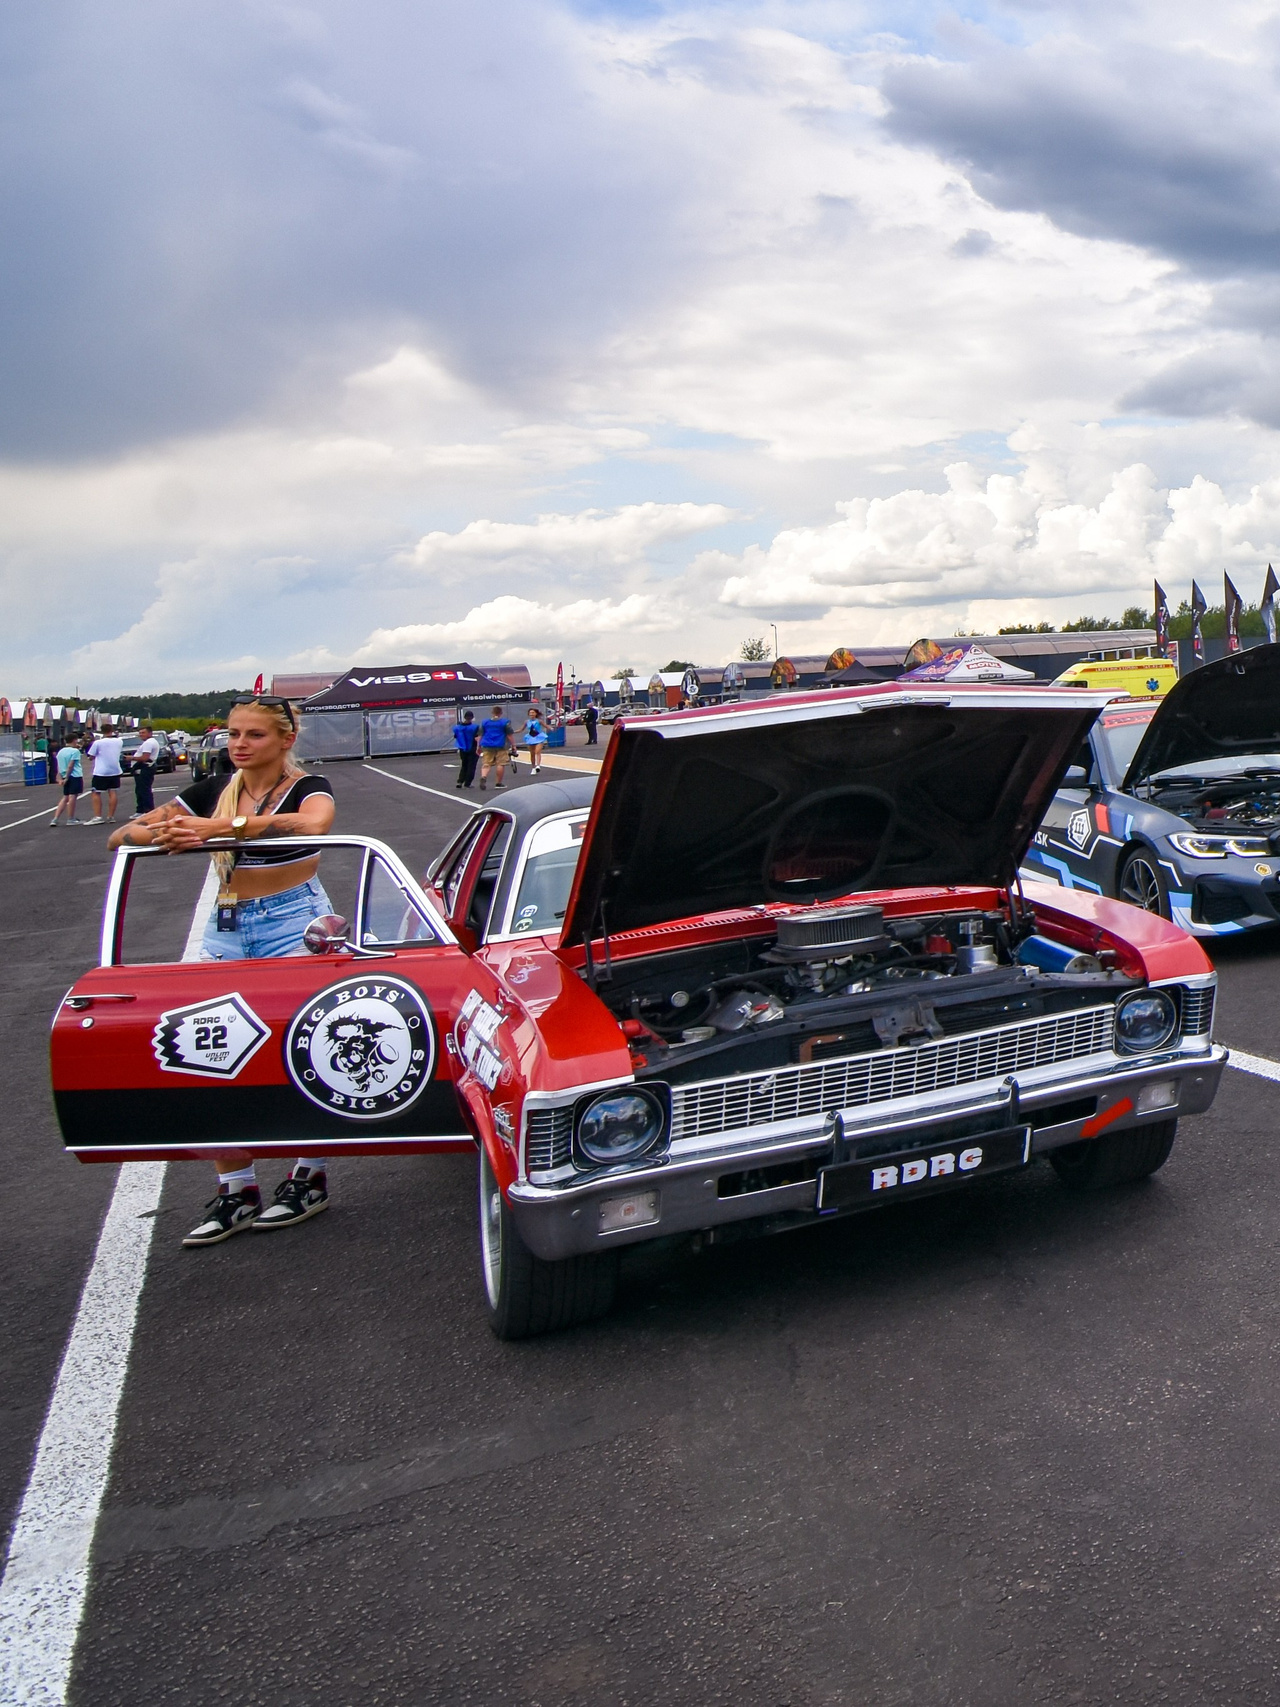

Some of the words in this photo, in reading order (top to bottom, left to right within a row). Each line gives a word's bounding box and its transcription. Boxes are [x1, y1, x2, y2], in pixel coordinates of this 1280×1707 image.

[968, 662, 1001, 670] MOTUL
[463, 692, 523, 701] vissolwheels.ru
[305, 703, 360, 712] ПРОИЗВОДСТВО
[193, 1016, 221, 1026] RDRC
[296, 1007, 326, 1050] BIG
[195, 1025, 228, 1051] 22
[329, 1091, 377, 1109] BIG
[387, 1048, 425, 1102] TOYS
[872, 1146, 983, 1191] RDRC
